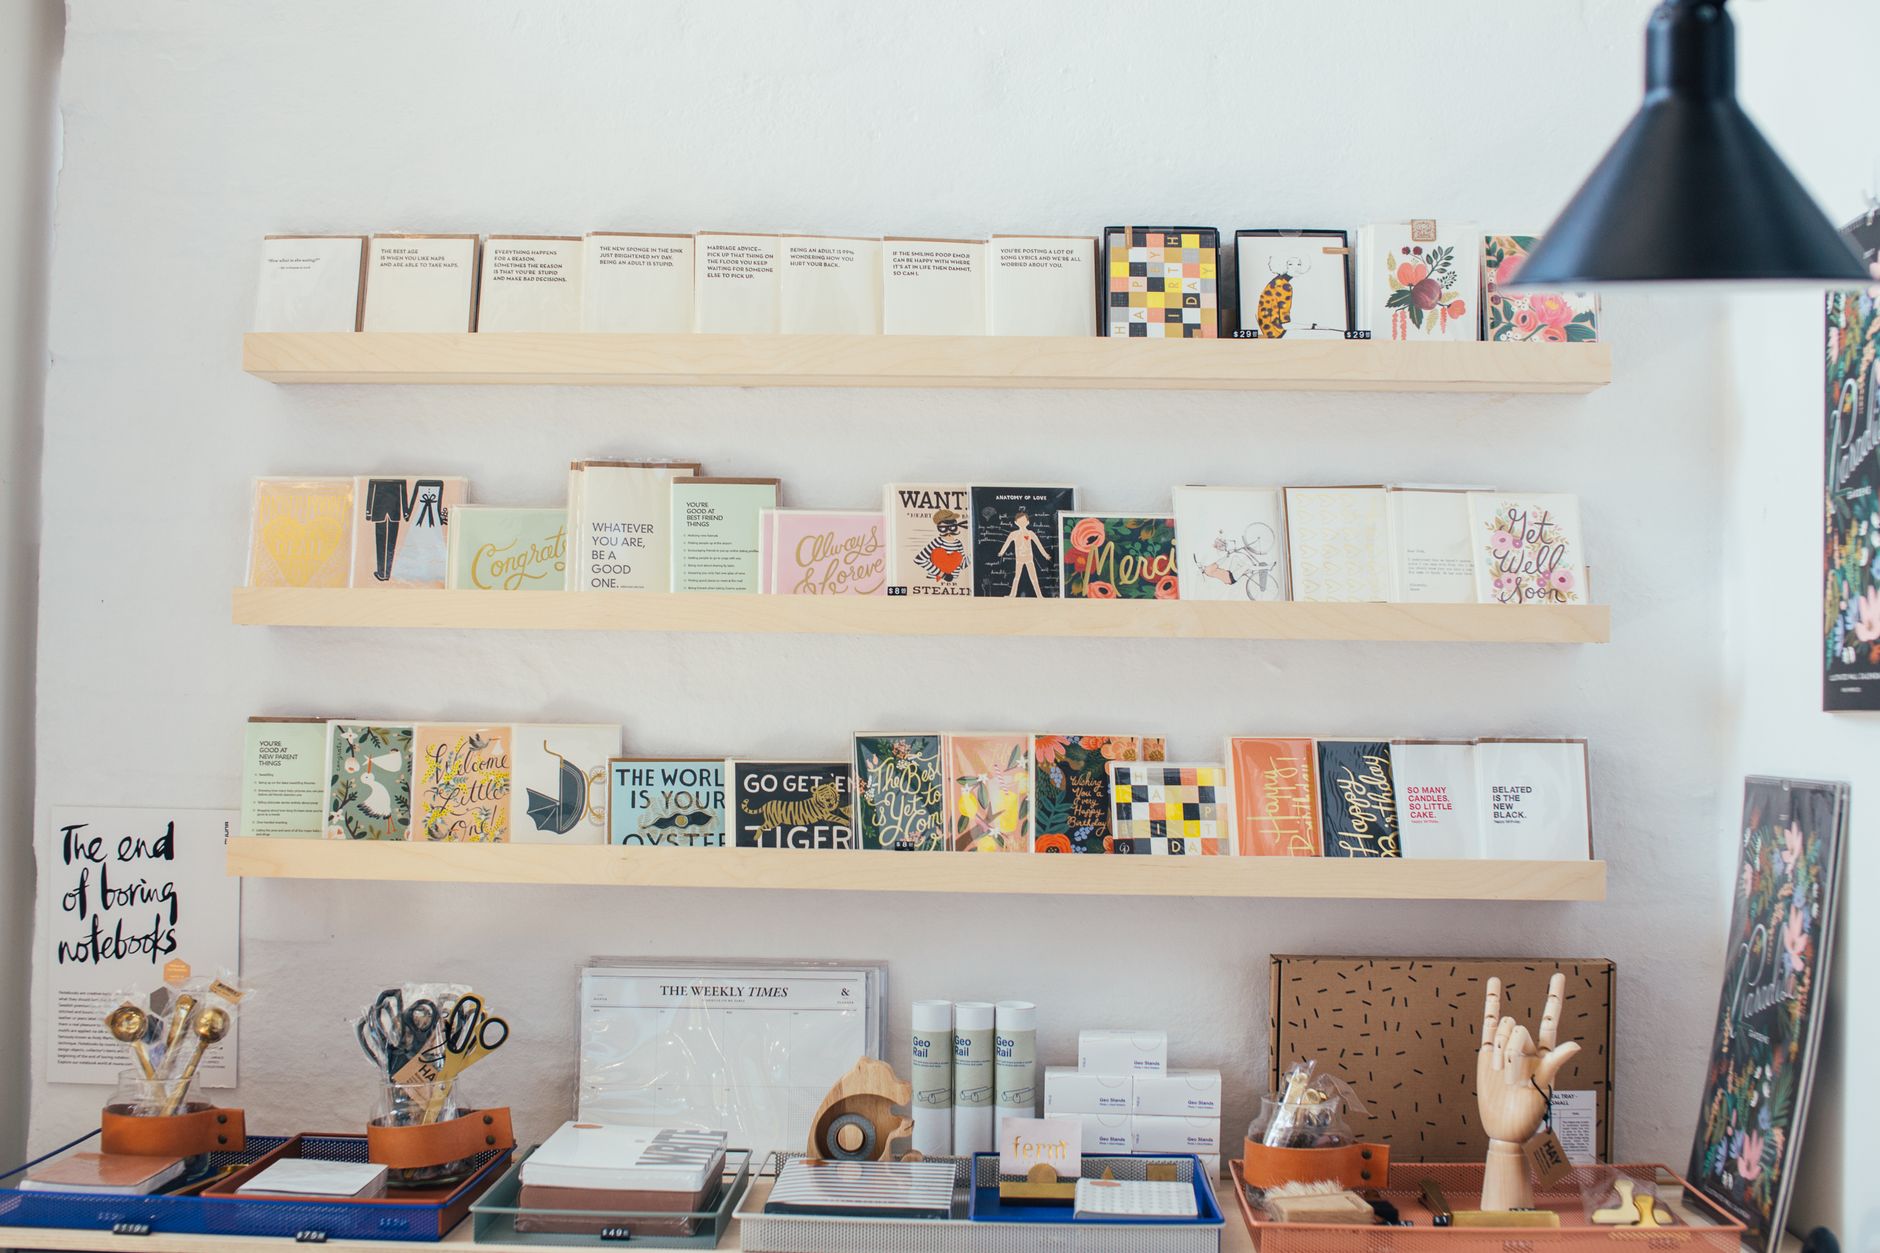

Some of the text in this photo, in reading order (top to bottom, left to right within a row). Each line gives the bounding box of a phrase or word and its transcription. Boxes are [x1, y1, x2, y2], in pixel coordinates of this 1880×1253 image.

[898, 490, 968, 510] WANT
[592, 522, 654, 534] WHATEVER
[1499, 508, 1555, 544] Get
[592, 536, 646, 548] YOU ARE,
[795, 526, 884, 568] Always
[592, 550, 616, 560] BE A
[1493, 544, 1565, 574] Well
[592, 564, 631, 574] GOOD
[1082, 538, 1178, 597] Merci
[591, 578, 619, 588] ONE.
[426, 741, 510, 783] Welcome
[616, 769, 724, 787] THE WORL
[868, 752, 942, 794] The Best
[744, 774, 778, 793] GO
[783, 775, 823, 793] GET
[424, 778, 505, 815] Little
[631, 790, 724, 809] IS YOUR
[872, 806, 886, 826] is
[921, 783, 942, 807] to
[1247, 756, 1304, 843] Happy
[1074, 805, 1105, 818] Happy
[1337, 766, 1378, 857] Happy
[60, 824, 107, 865] The
[118, 821, 174, 862] end
[745, 825, 851, 849] TIGER
[63, 862, 178, 926] of boring
[58, 913, 177, 964] notebooks
[660, 985, 788, 997] THE WEEKLY TIMES
[841, 988, 849, 996] &
[913, 1036, 930, 1048] Geo
[954, 1036, 971, 1046] Geo
[996, 1036, 1014, 1047] Geo
[913, 1047, 928, 1058] Rail
[954, 1046, 969, 1056] Rail
[996, 1047, 1012, 1057] Rail
[418, 1064, 436, 1082] HA
[1543, 1140, 1562, 1164] HAY
